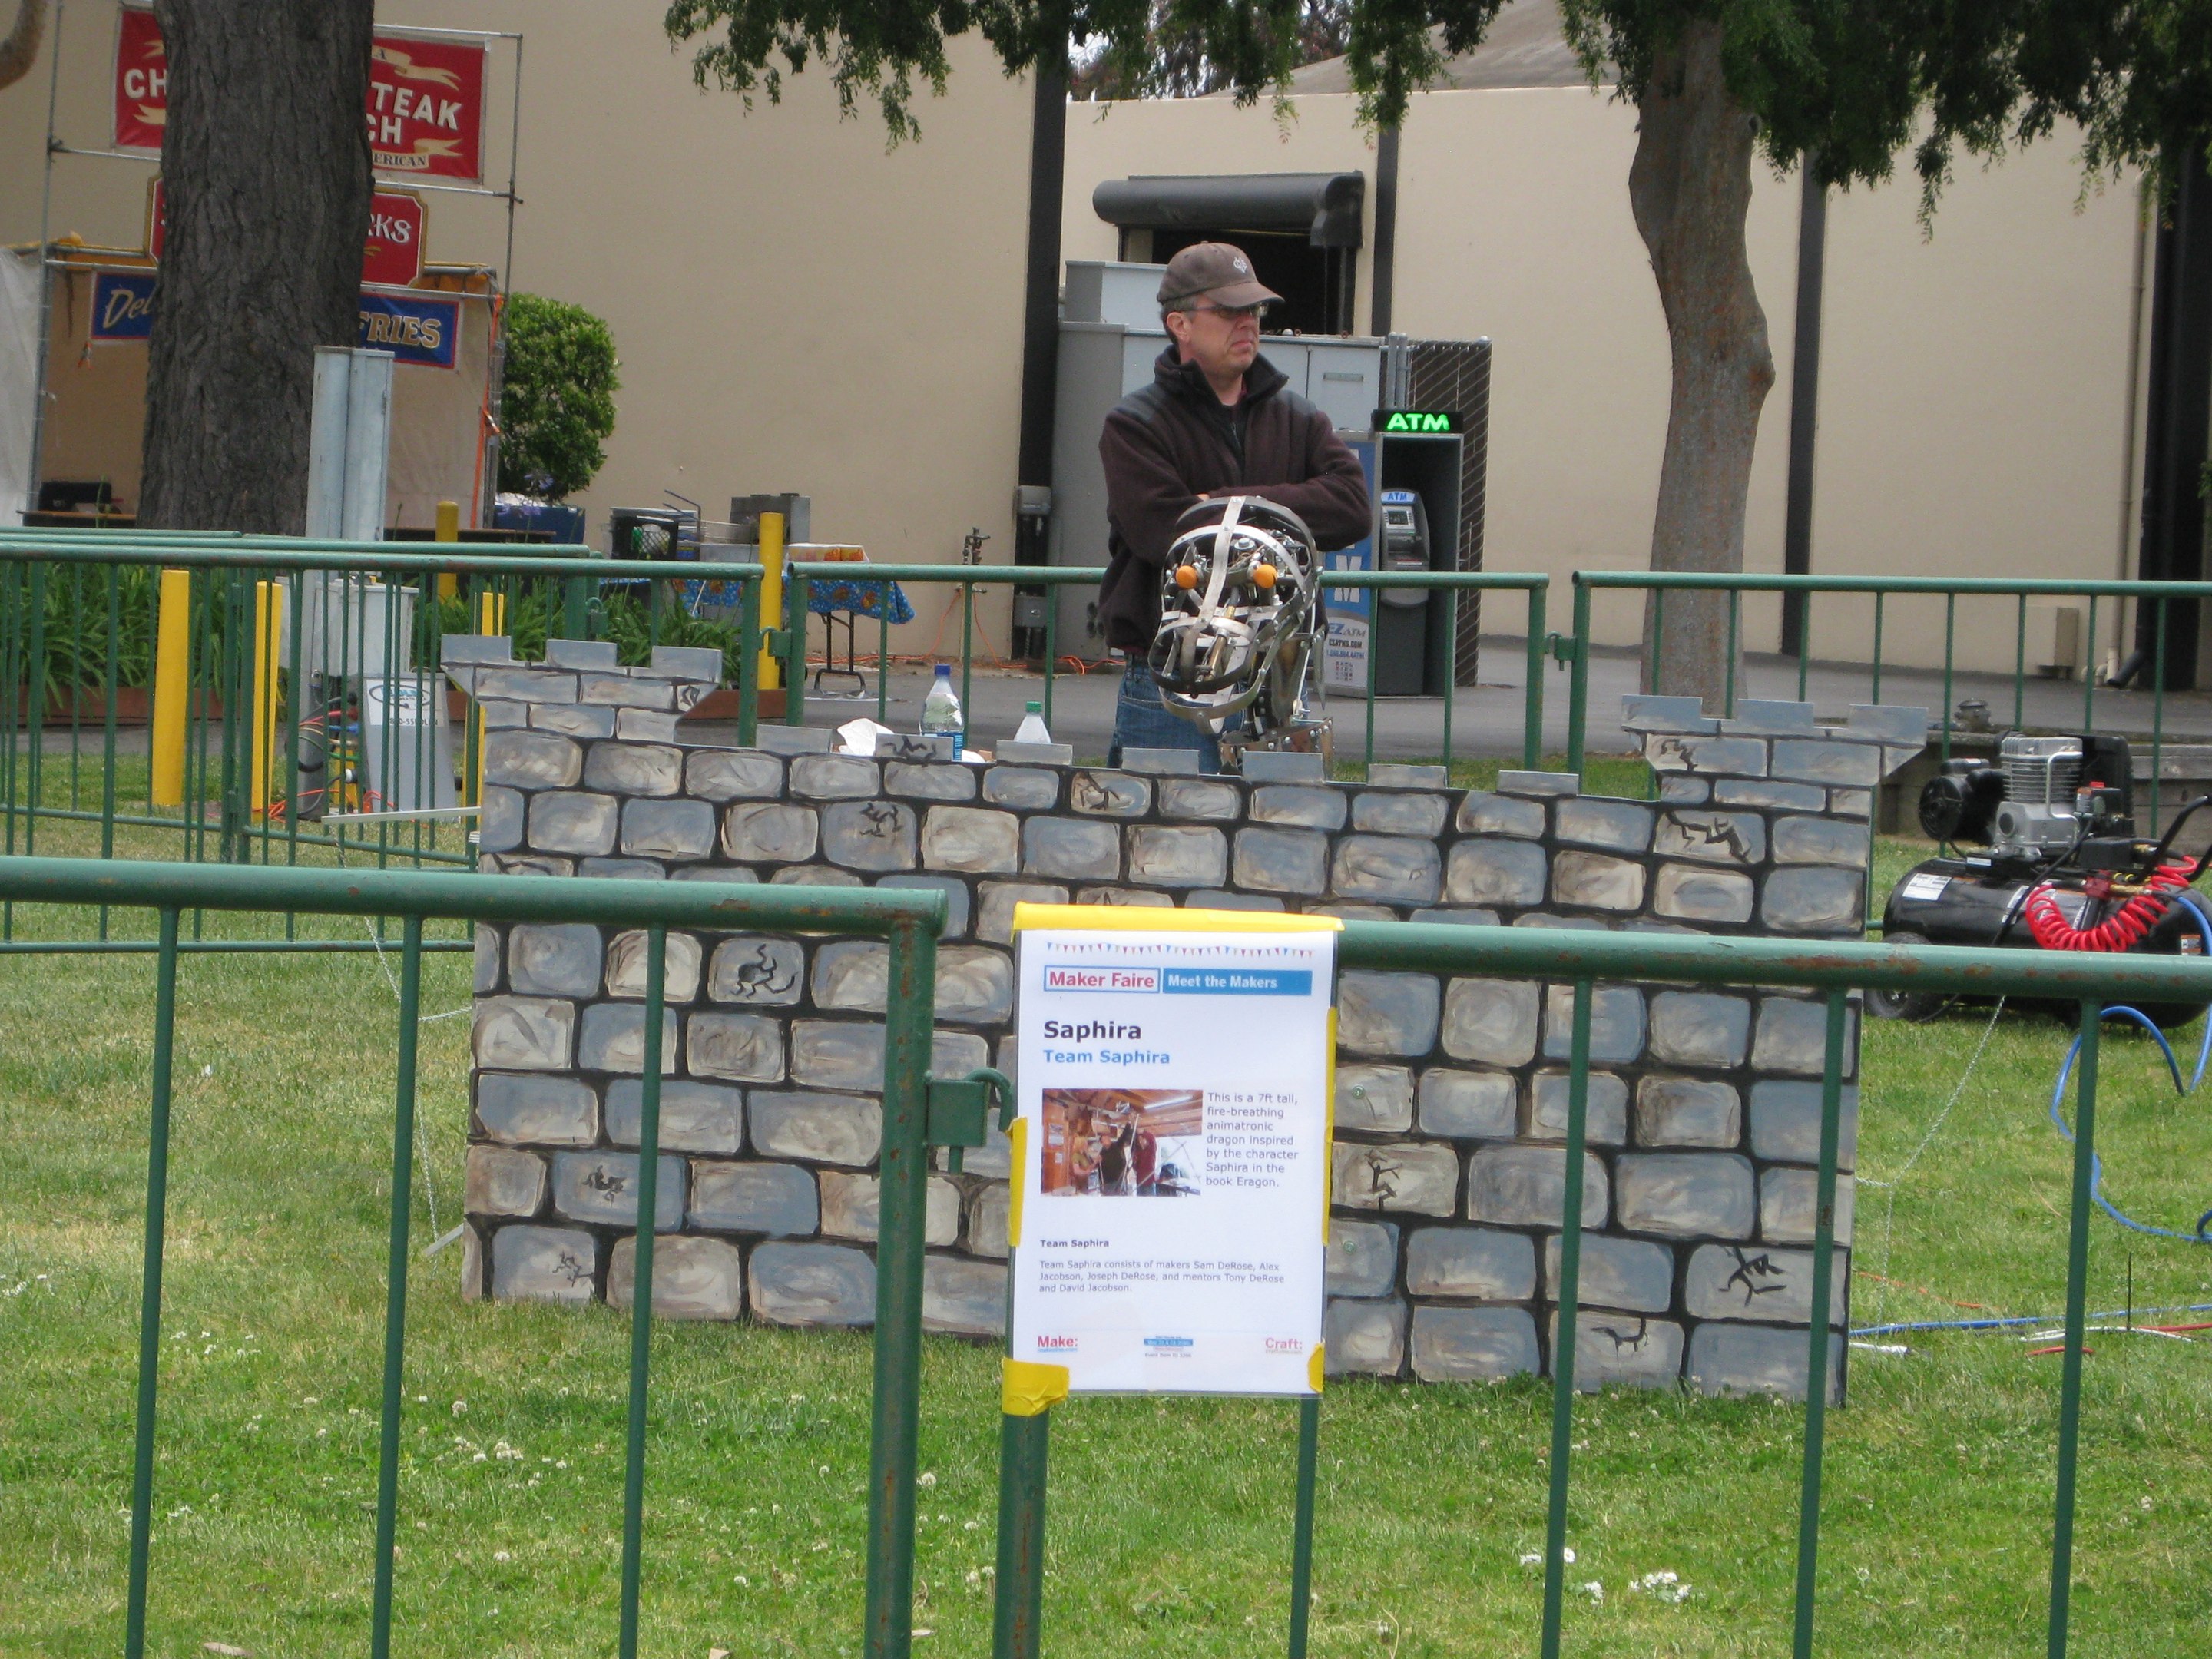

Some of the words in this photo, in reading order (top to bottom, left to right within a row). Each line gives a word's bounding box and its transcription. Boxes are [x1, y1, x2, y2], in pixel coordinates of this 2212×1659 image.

[370, 81, 462, 131] TEAK
[373, 154, 426, 166] ERICAN
[1386, 412, 1450, 431] ATM
[1387, 492, 1407, 501] ATM
[1049, 971, 1105, 988] Maker
[1111, 972, 1154, 988] Faire
[1167, 974, 1201, 988] Meet
[1204, 975, 1227, 988] the
[1230, 975, 1278, 989] Makers
[1044, 1020, 1141, 1043] Saphira
[1043, 1049, 1093, 1063] Team
[1100, 1049, 1171, 1066] Saphira
[1207, 1092, 1230, 1103] This
[1234, 1093, 1243, 1103] is
[1247, 1094, 1253, 1103] a
[1258, 1093, 1273, 1104] 7ft
[1277, 1094, 1298, 1105] tall,
[1207, 1106, 1284, 1120] fire-breathing
[1207, 1121, 1273, 1131] animatronic
[1206, 1134, 1245, 1147] dragon
[1249, 1135, 1294, 1147] inspired
[1206, 1148, 1220, 1160] by
[1224, 1148, 1242, 1159] the
[1245, 1149, 1299, 1160] character
[1206, 1162, 1248, 1174] Saphira
[1252, 1163, 1263, 1173] in
[1267, 1164, 1285, 1174] the
[1206, 1176, 1233, 1187] book
[1237, 1177, 1279, 1189] Eragon.
[1040, 1239, 1068, 1248] Team
[1071, 1239, 1109, 1250] Saphira
[1039, 1260, 1064, 1270] Team
[1067, 1260, 1101, 1271] Saphira
[1104, 1260, 1141, 1270] consists
[1144, 1260, 1154, 1270] of
[1156, 1260, 1190, 1270] makers
[1194, 1260, 1214, 1270] Sam
[1217, 1261, 1256, 1271] DeRose,
[1259, 1262, 1280, 1271] Alex
[1039, 1271, 1084, 1282] Jacobson,
[1087, 1271, 1118, 1283] Joseph
[1121, 1272, 1158, 1282] DeRose,
[1162, 1272, 1180, 1281] and
[1182, 1273, 1221, 1282] mentors
[1224, 1273, 1247, 1284] Tony
[1249, 1273, 1285, 1283] DeRose
[1038, 1283, 1057, 1293] and
[1059, 1283, 1085, 1293] David
[1087, 1283, 1132, 1293] Jacobson.
[1038, 1336, 1078, 1348] Make:
[1265, 1337, 1303, 1349] Craft:
